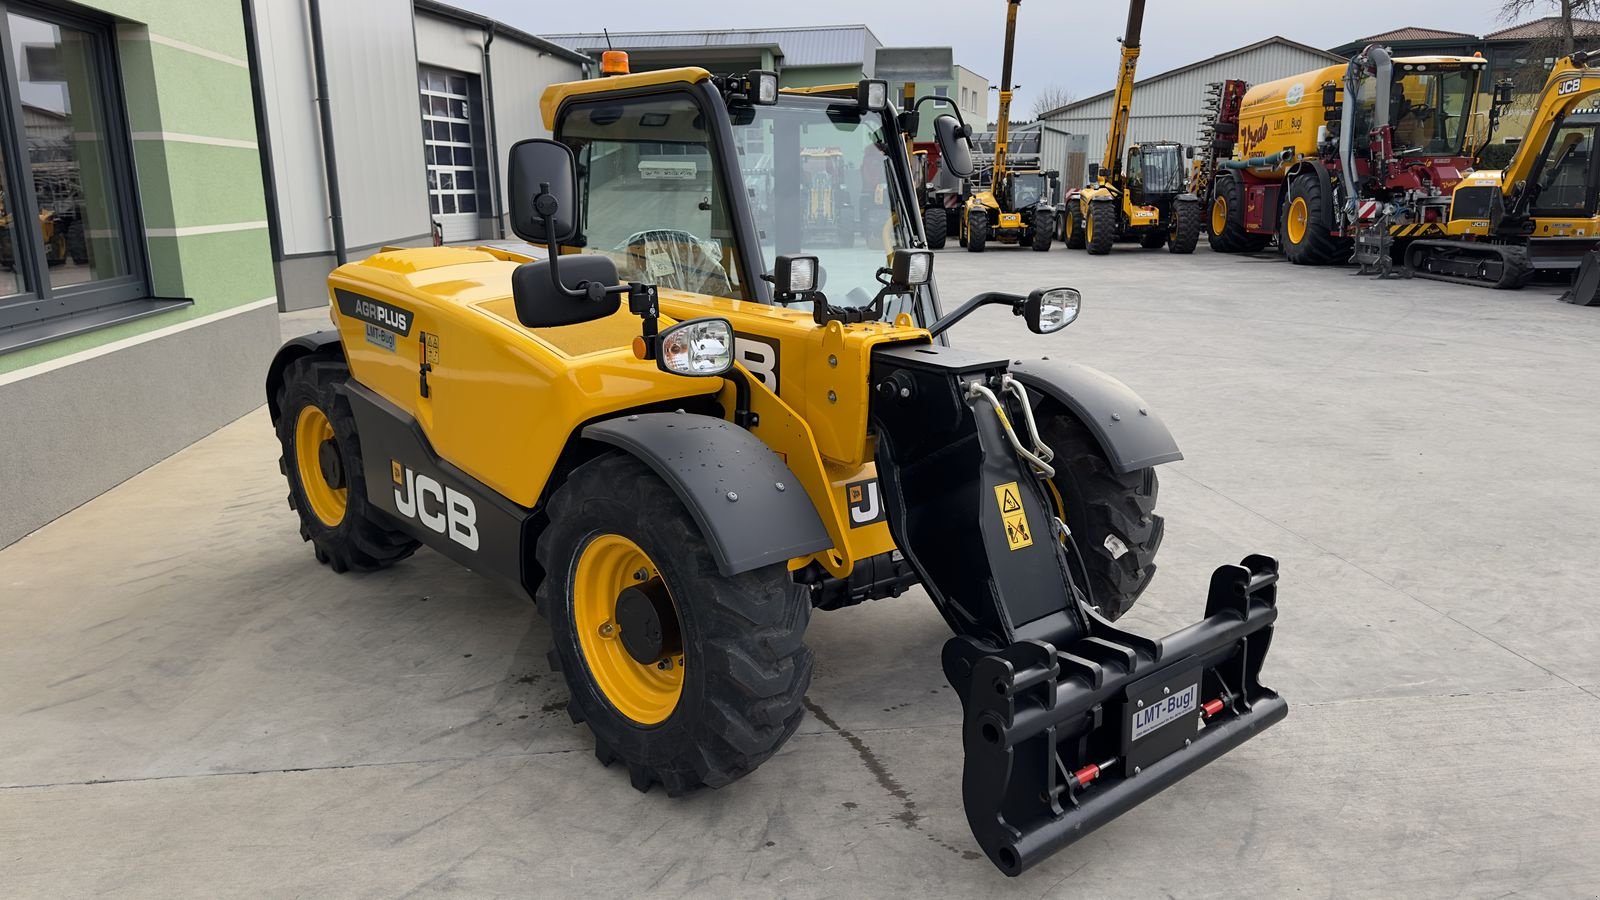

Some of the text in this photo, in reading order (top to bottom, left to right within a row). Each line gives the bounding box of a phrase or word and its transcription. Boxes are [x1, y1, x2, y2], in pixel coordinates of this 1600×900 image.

[1558, 79, 1581, 95] JCB
[1241, 115, 1268, 156] Vredo
[394, 467, 479, 551] JCB
[1136, 687, 1194, 729] LMT-Bugl
